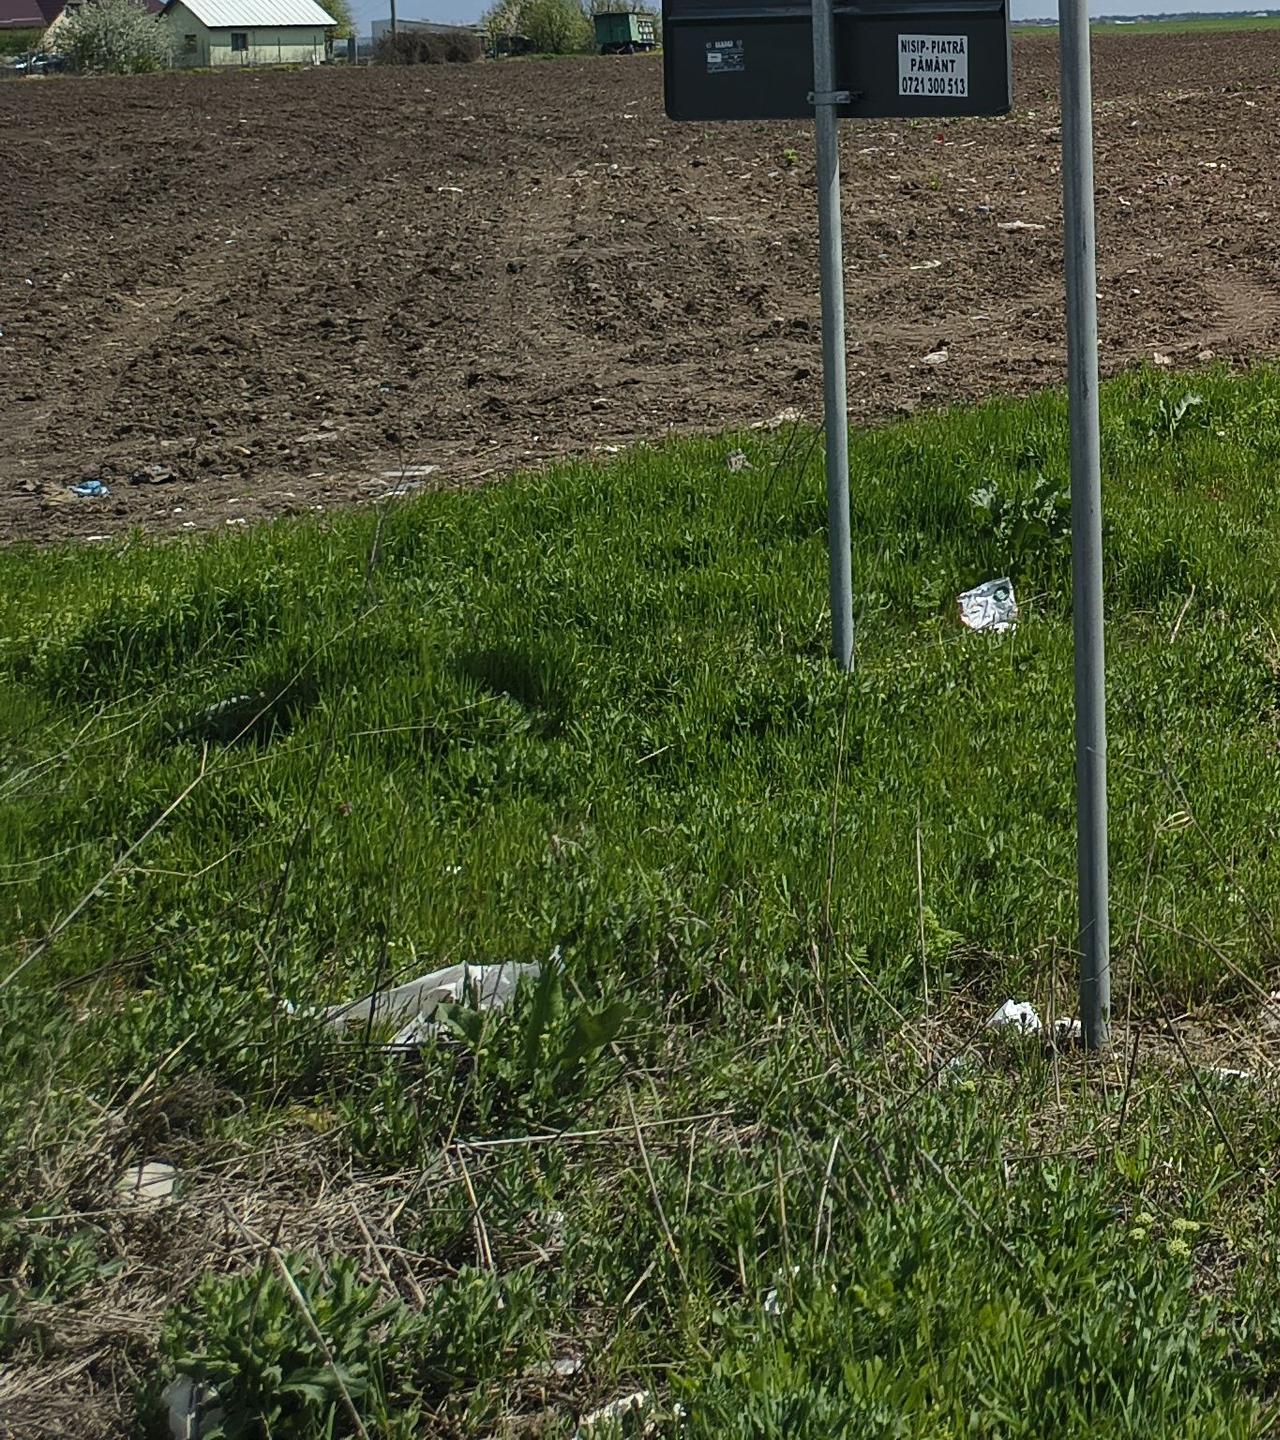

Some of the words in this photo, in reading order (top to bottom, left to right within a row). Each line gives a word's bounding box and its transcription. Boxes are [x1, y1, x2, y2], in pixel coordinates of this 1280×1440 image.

[902, 76, 925, 93] 0721
[927, 77, 946, 94] 300
[947, 77, 966, 95] 513
